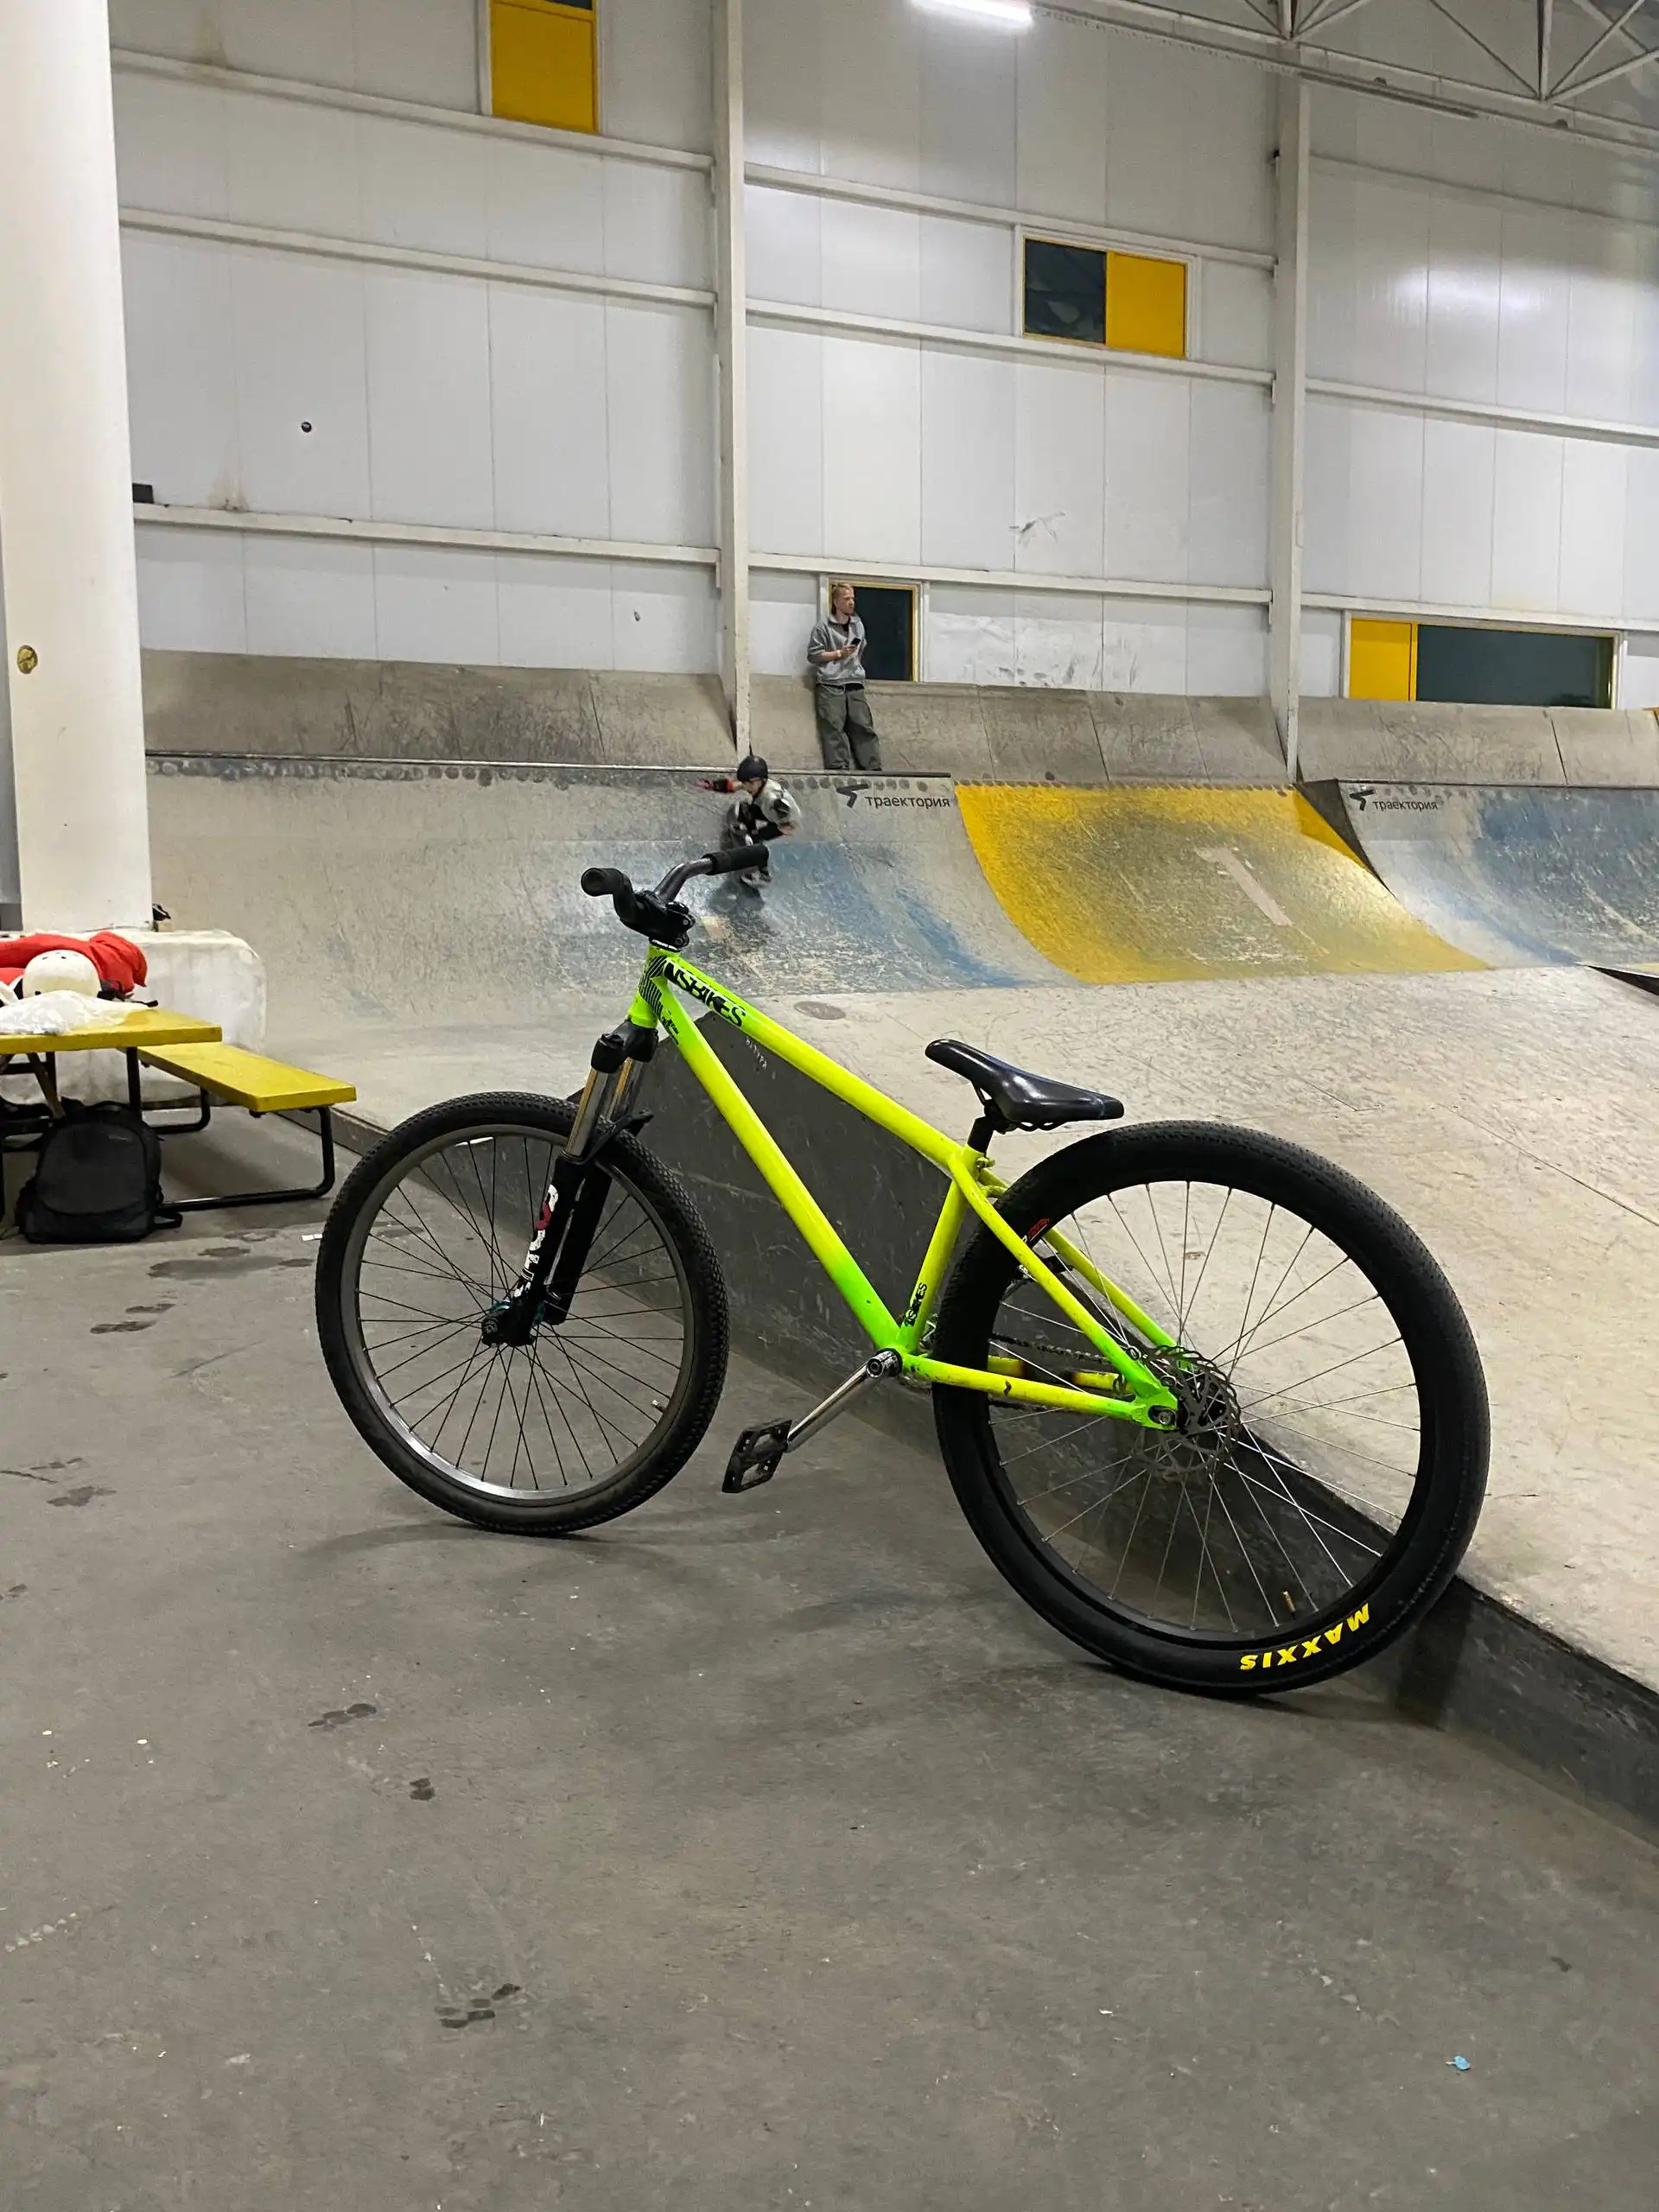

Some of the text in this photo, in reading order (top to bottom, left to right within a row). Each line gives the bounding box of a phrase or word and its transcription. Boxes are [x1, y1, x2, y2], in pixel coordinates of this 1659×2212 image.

[865, 796, 950, 810] траектория
[1372, 801, 1439, 812] траектория
[1239, 1603, 1370, 1671] MAXXIS
